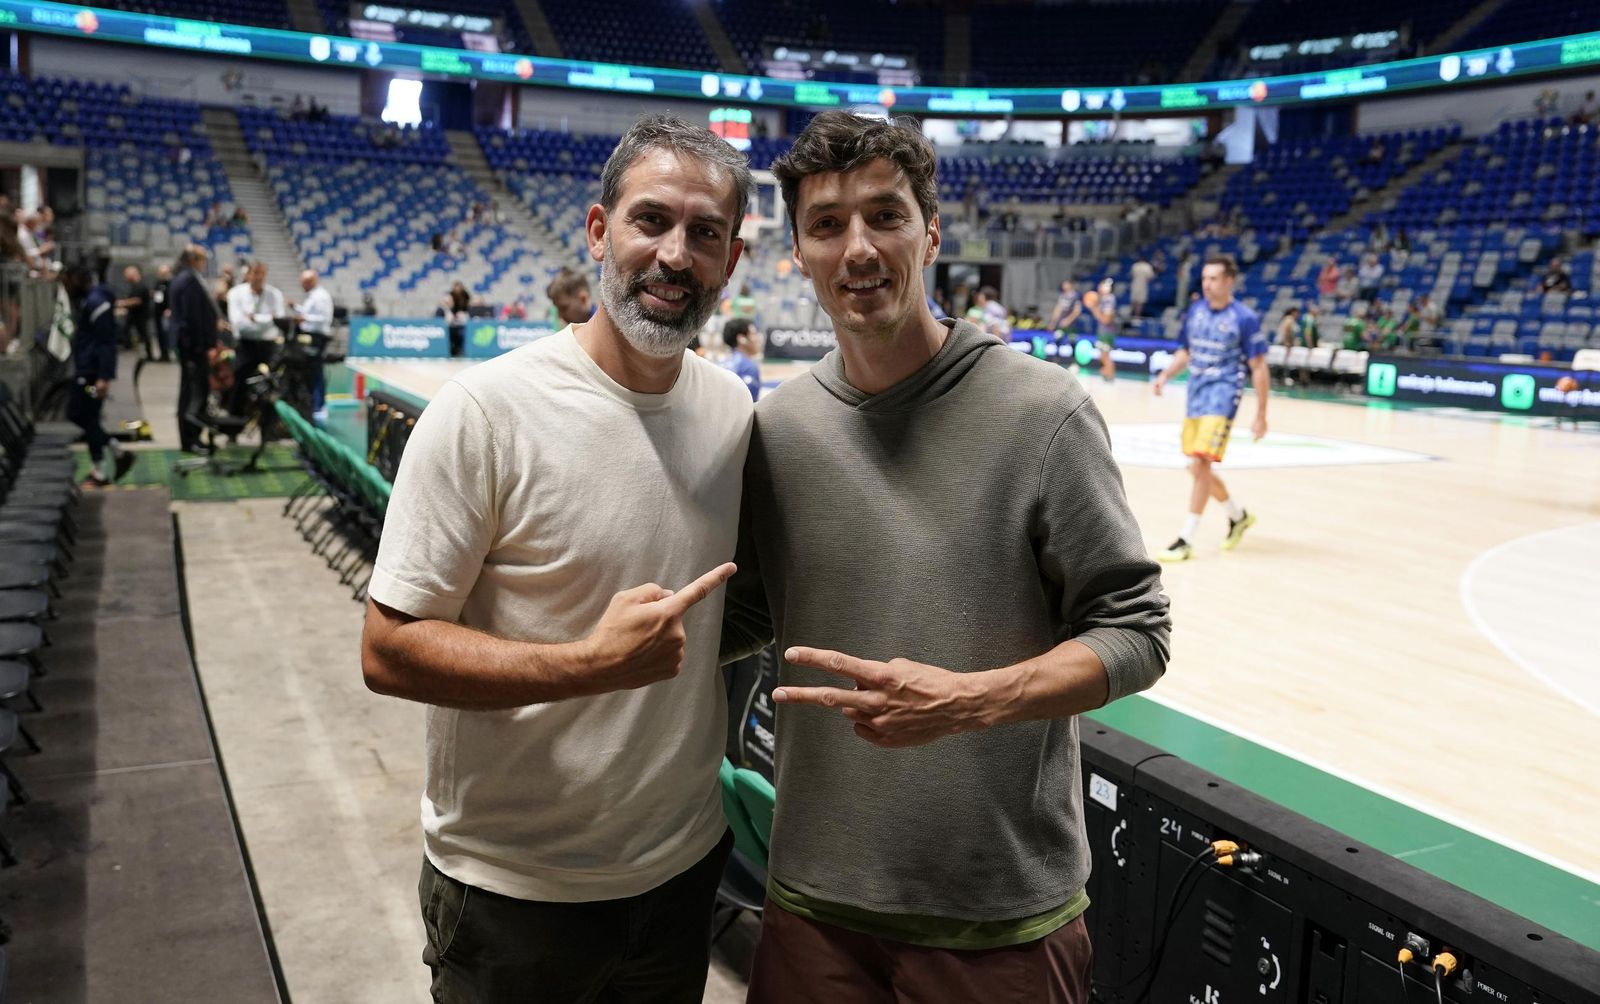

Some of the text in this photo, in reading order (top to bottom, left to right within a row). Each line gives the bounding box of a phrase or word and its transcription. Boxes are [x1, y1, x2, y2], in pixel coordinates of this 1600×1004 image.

[1095, 780, 1110, 800] 23
[1160, 817, 1182, 842] 24
[1368, 922, 1395, 940] SIGNAL OUT
[1477, 981, 1508, 1002] POWER OUT
